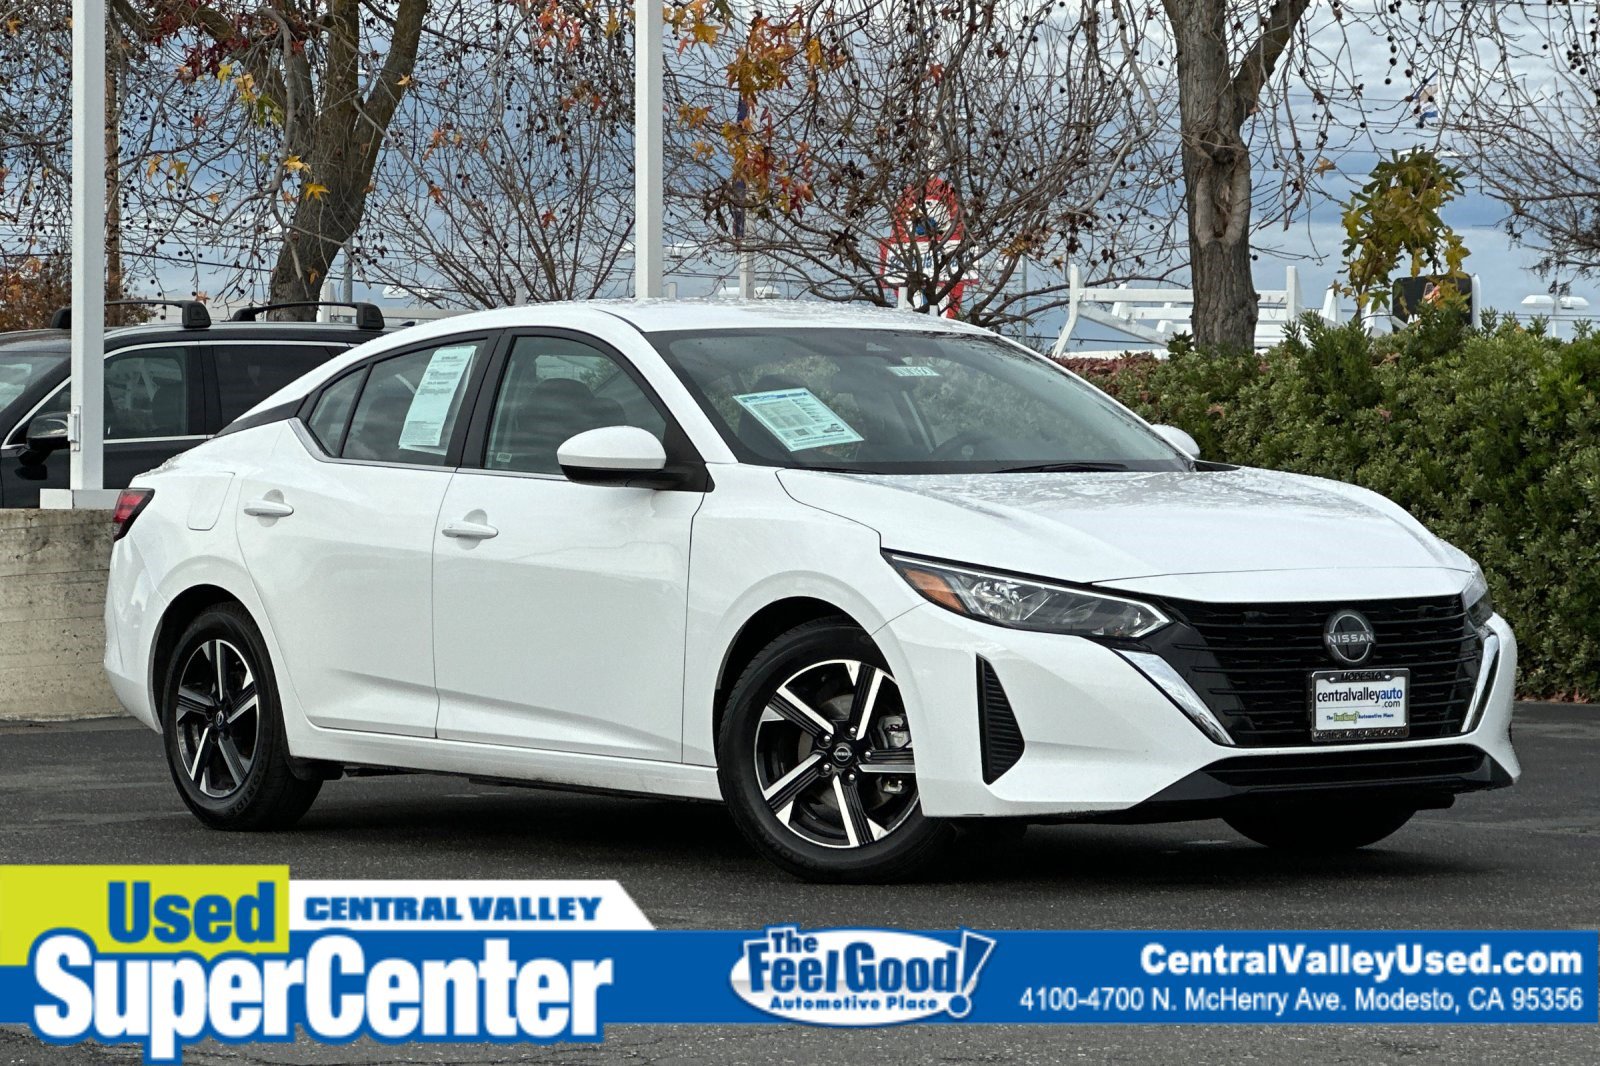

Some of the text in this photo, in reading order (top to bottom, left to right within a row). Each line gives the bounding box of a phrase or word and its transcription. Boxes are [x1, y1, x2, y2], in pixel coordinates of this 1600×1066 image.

[1327, 633, 1374, 643] NISSAN
[1317, 686, 1403, 703] centralvalleyauto
[1382, 700, 1401, 708] .com
